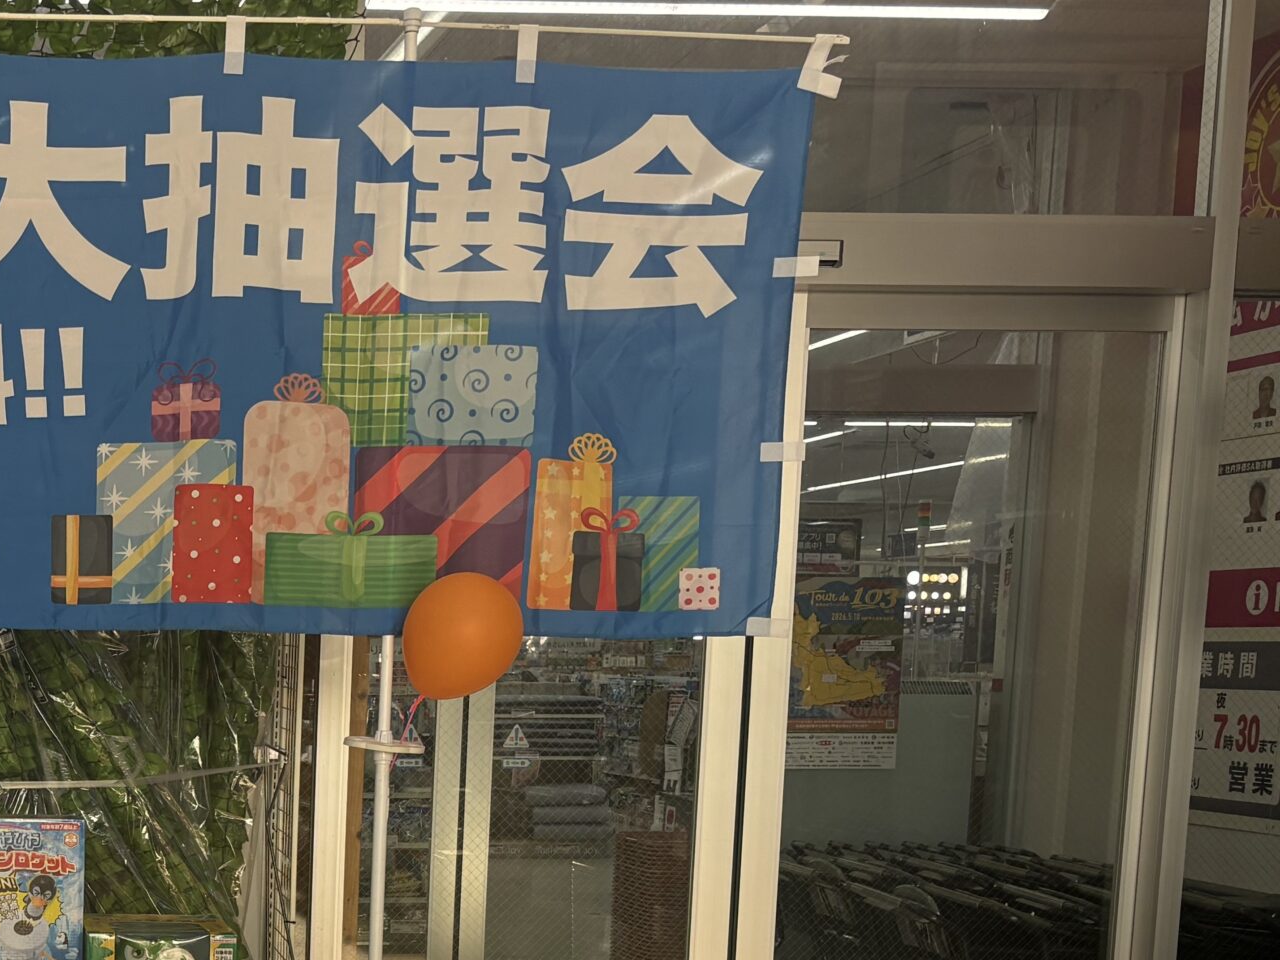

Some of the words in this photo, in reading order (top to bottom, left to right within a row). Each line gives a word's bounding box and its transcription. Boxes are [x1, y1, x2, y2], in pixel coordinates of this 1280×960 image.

[851, 587, 902, 609] 103
[1216, 693, 1227, 708] 夜
[1229, 761, 1274, 796] 営業
